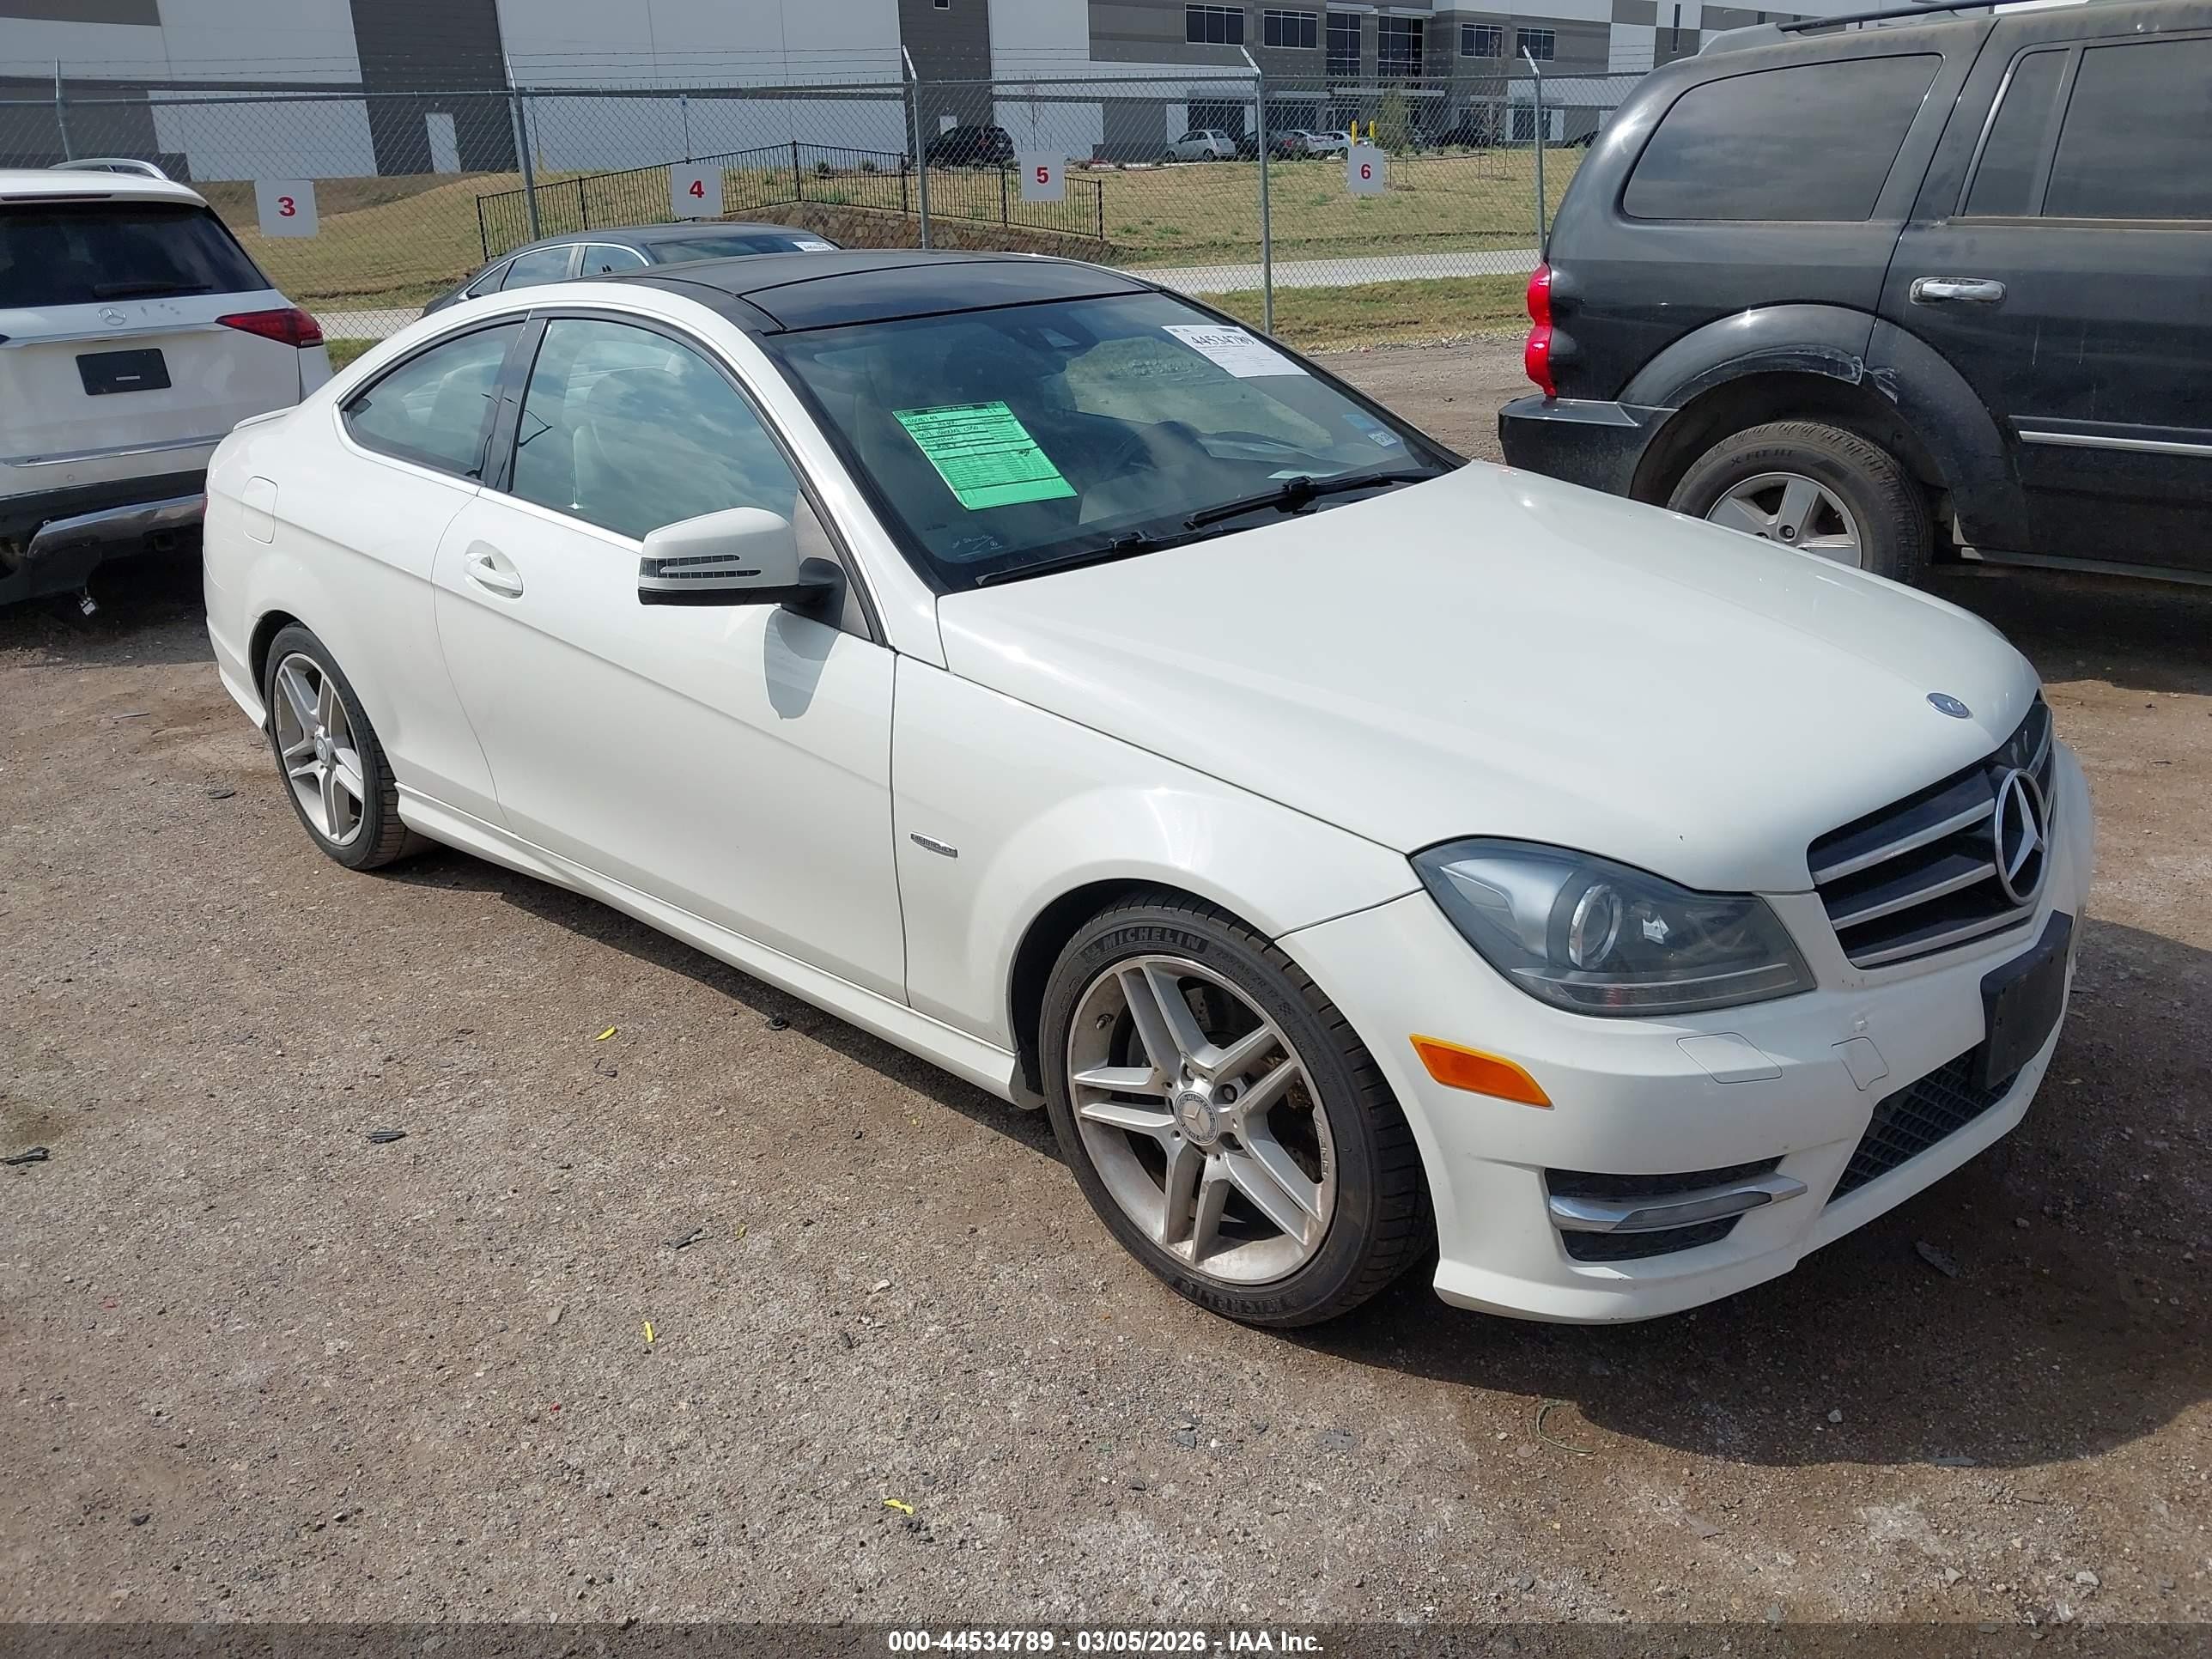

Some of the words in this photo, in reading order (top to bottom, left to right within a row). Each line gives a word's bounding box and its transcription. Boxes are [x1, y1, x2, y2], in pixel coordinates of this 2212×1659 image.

[1036, 166, 1049, 185] 5
[1360, 163, 1371, 179] 6
[690, 179, 705, 198] 4
[278, 196, 297, 217] 3
[1190, 335, 1255, 346] 44534789
[1103, 927, 1202, 951] MICHELIN
